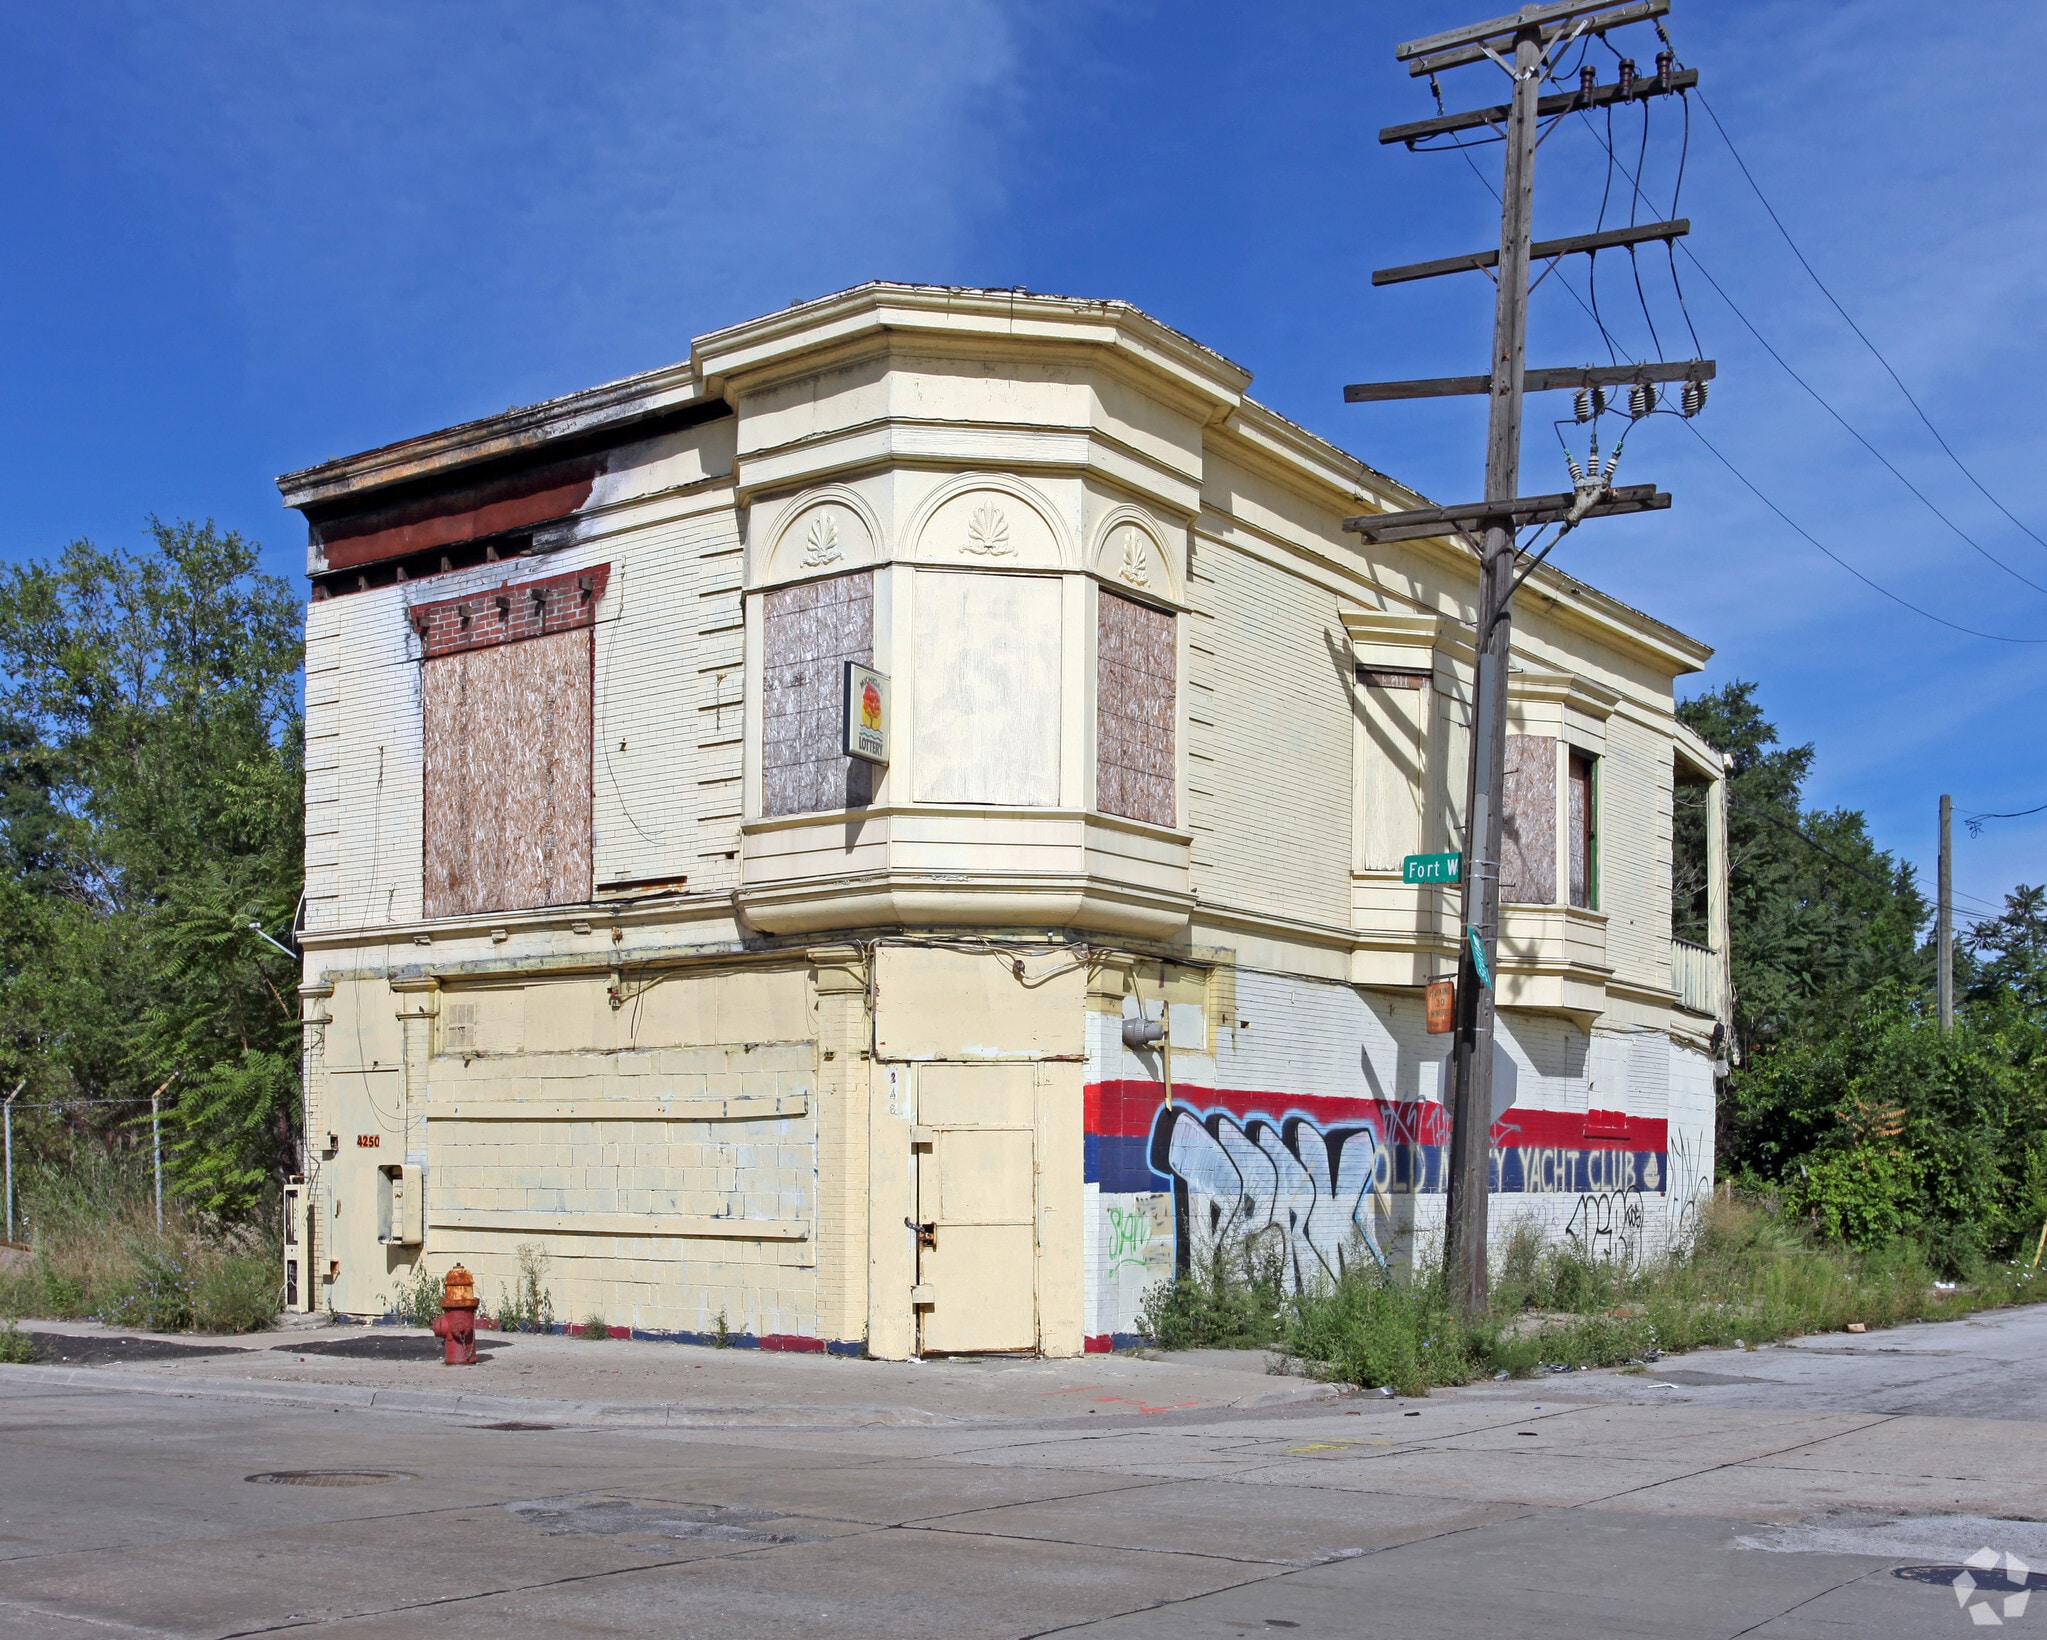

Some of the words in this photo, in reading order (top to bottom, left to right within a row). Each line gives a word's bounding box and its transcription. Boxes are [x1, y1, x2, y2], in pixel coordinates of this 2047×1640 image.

[859, 736, 883, 757] LOTTERY
[1409, 861, 1440, 878] Fort
[357, 1134, 380, 1148] 4250
[1372, 1144, 1426, 1194] OLD
[1517, 1145, 1580, 1194] YACHT
[1587, 1148, 1637, 1192] CLUB
